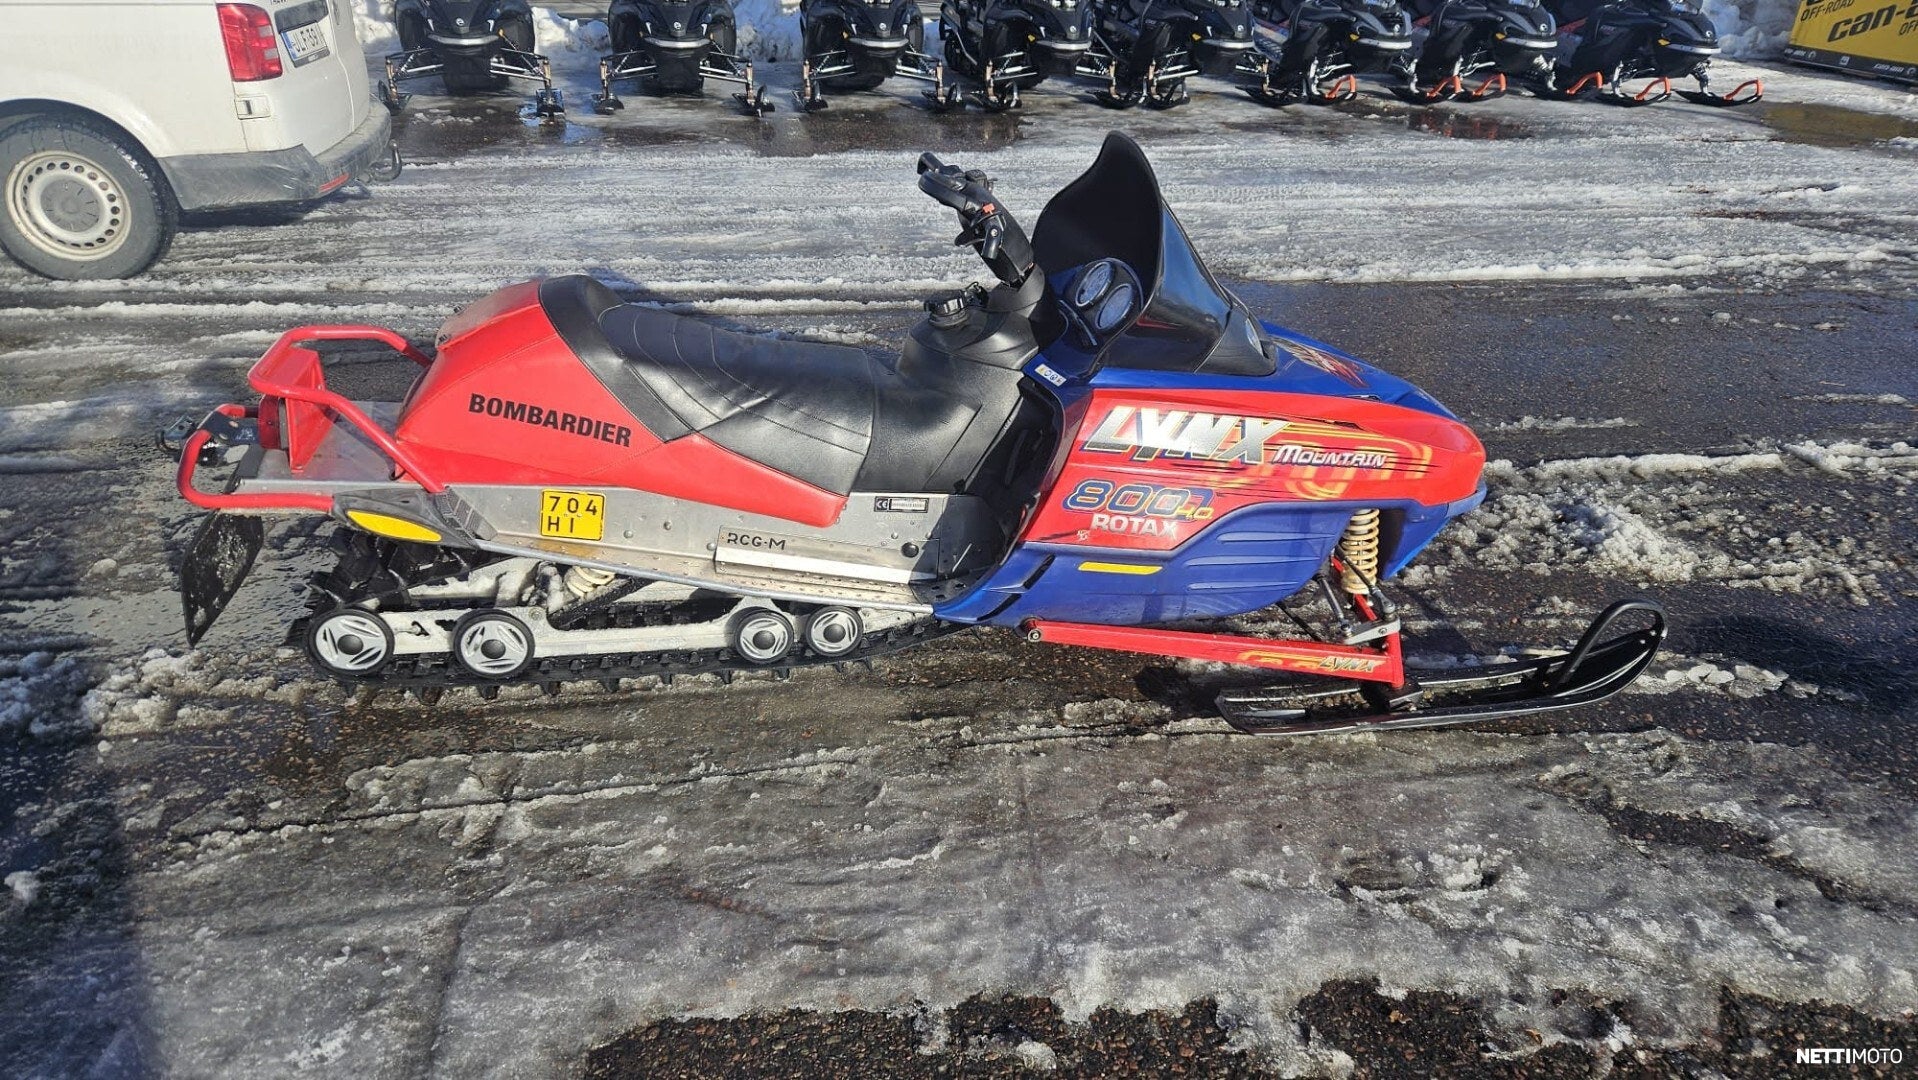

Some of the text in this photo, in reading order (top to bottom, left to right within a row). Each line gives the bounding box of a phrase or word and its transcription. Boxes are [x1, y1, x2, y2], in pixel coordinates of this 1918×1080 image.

[1800, 0, 1855, 21] OFF-ROAD
[469, 393, 633, 448] BOMBARDIER
[1082, 405, 1387, 468] LYNX MOUNTAIN
[548, 495, 598, 516] 704
[1063, 478, 1192, 518] 800
[547, 515, 575, 534] HI
[1091, 513, 1180, 541] ROTAX
[726, 532, 786, 551] RCG-M
[1319, 656, 1378, 673] LYNX
